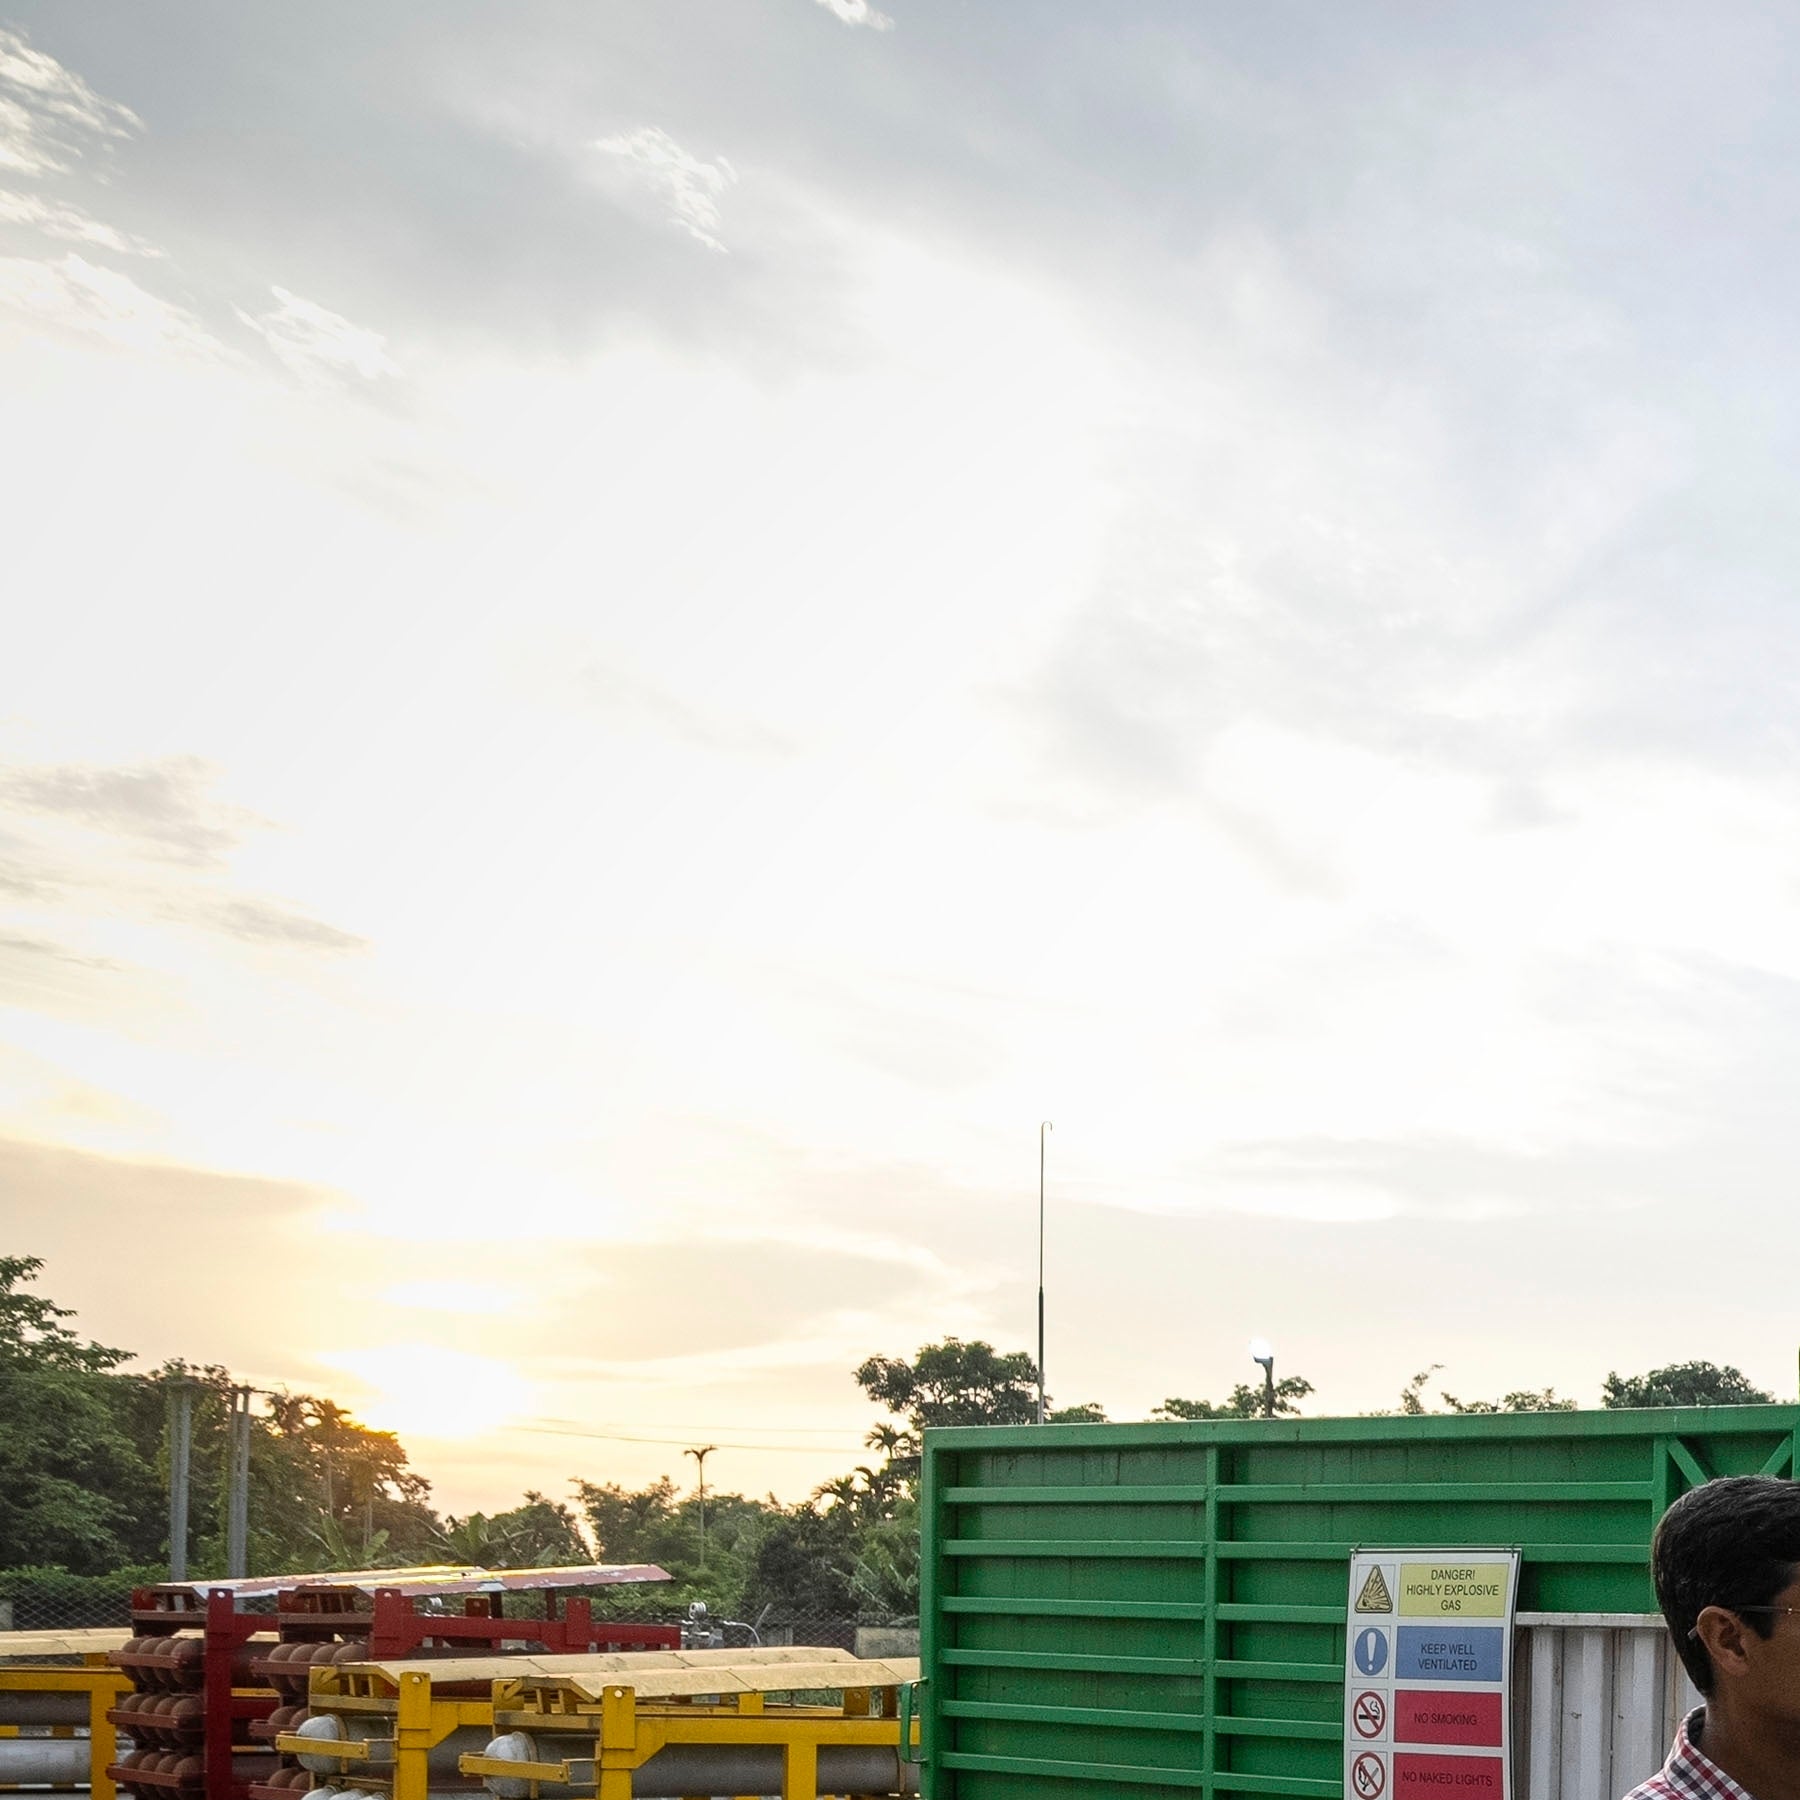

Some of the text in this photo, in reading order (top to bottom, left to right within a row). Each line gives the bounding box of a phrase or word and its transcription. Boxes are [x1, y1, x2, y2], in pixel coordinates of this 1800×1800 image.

[1431, 1569, 1476, 1581] DANGER!
[1406, 1584, 1499, 1596] HIGHLY EXPLOSIVE
[1440, 1600, 1461, 1611] GAS
[1420, 1643, 1475, 1656] KEEP WELL
[1418, 1658, 1478, 1671] VENTILATED
[1414, 1713, 1478, 1726] NO SMOKING
[1402, 1771, 1493, 1787] NO NAKED LIGHTS
